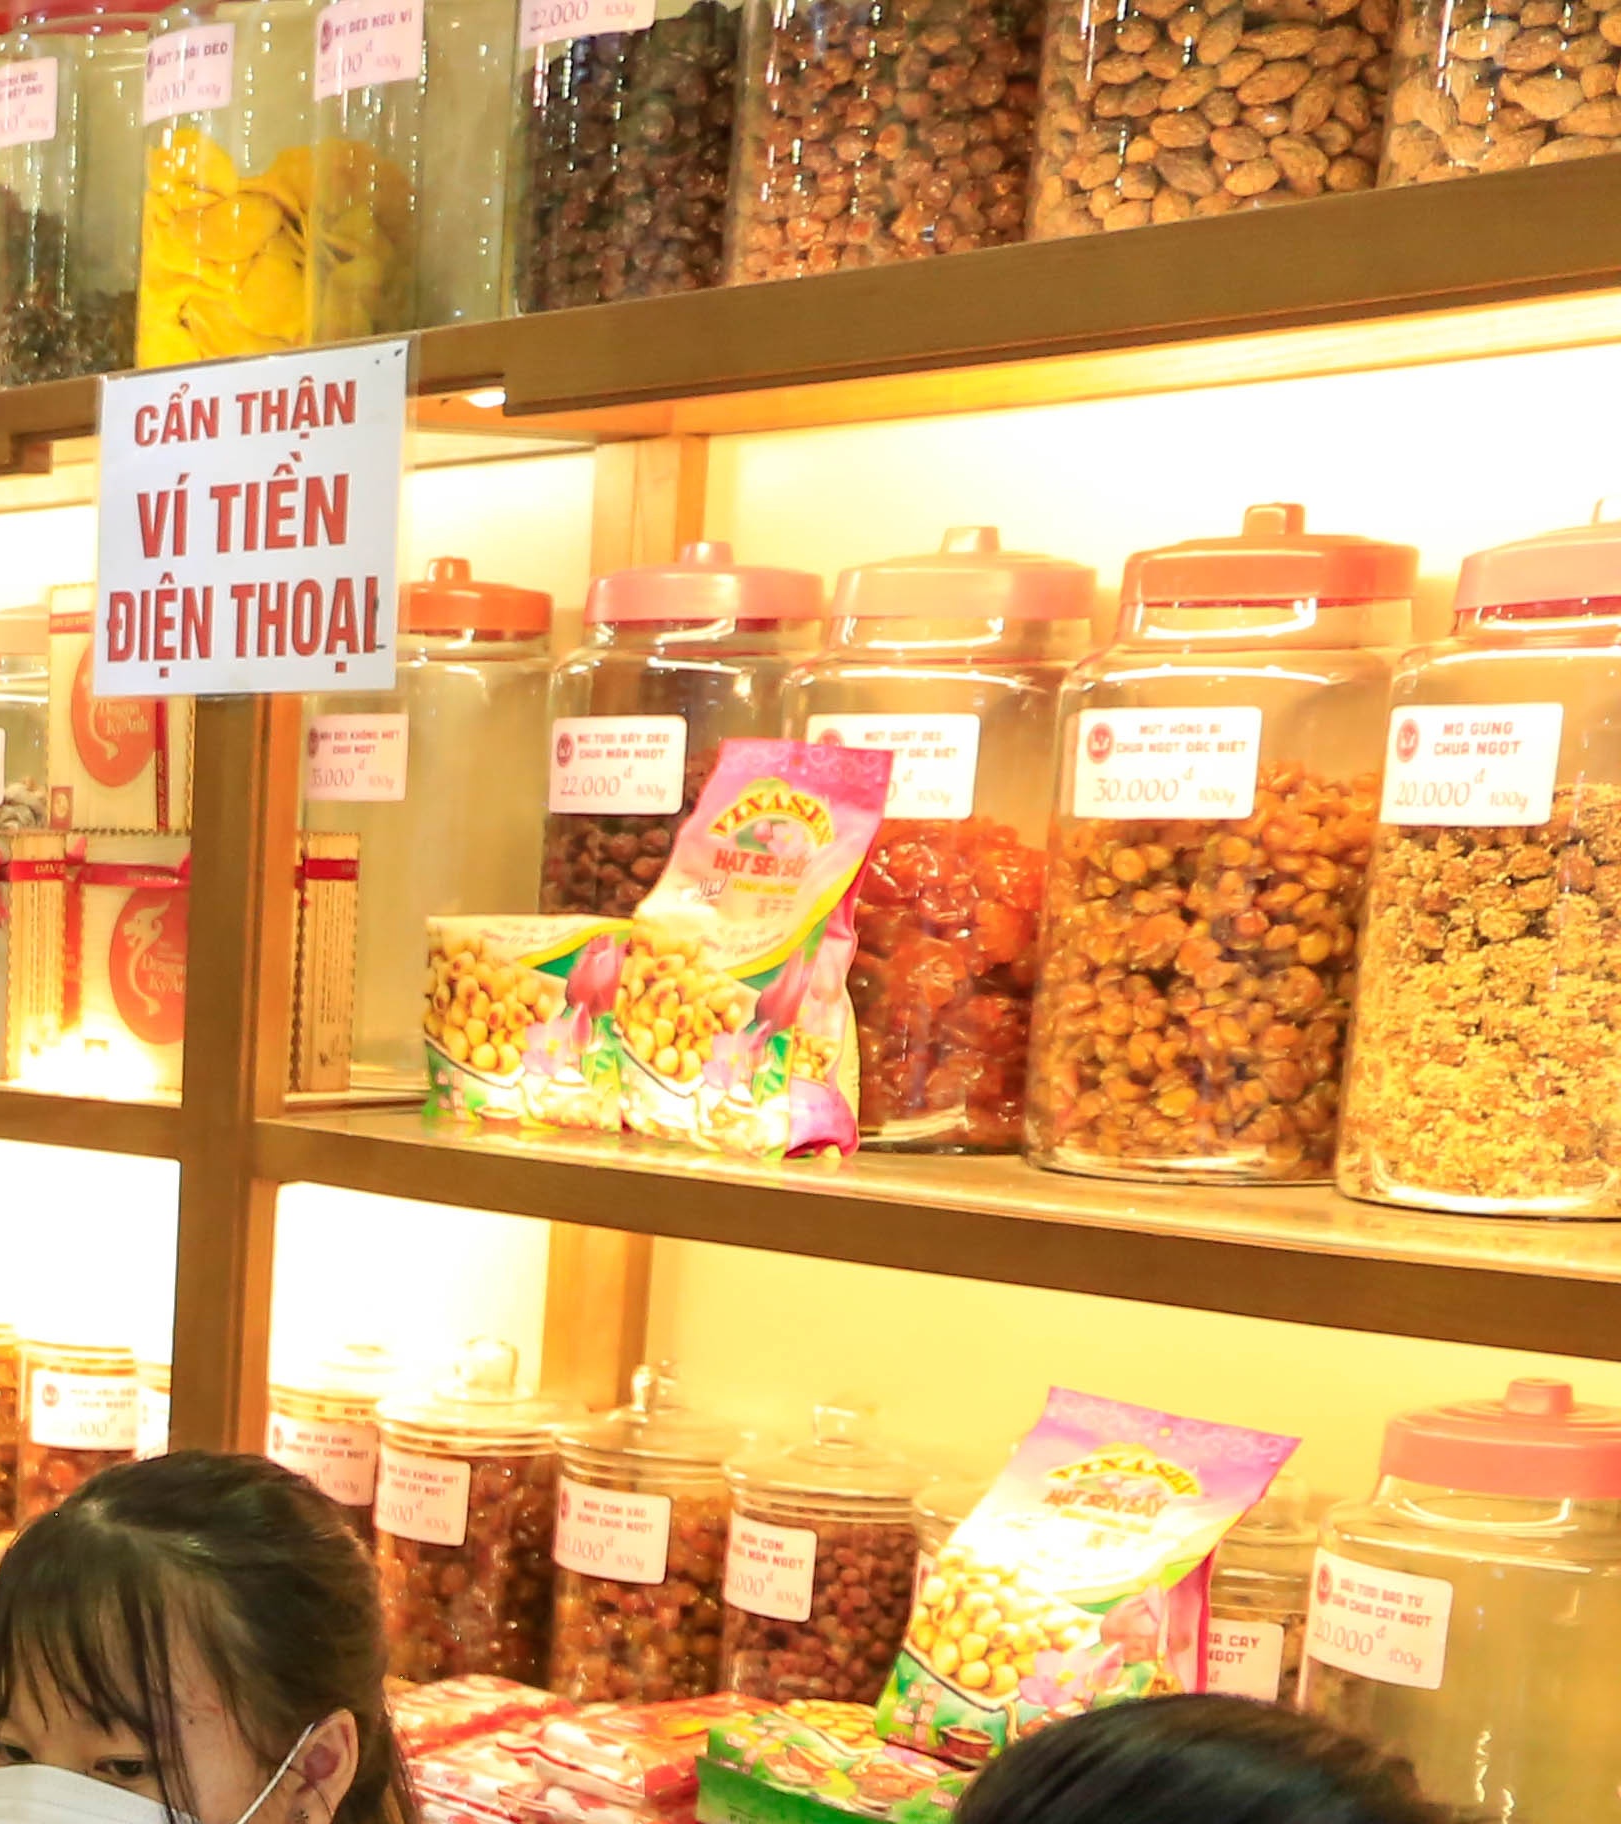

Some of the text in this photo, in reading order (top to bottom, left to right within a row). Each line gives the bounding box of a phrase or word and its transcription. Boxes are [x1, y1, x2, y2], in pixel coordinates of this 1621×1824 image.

[134, 376, 356, 447] CẨN THẬN
[137, 451, 349, 559] VÍ TIỀN
[107, 572, 379, 678] ĐIỆN THOẠI
